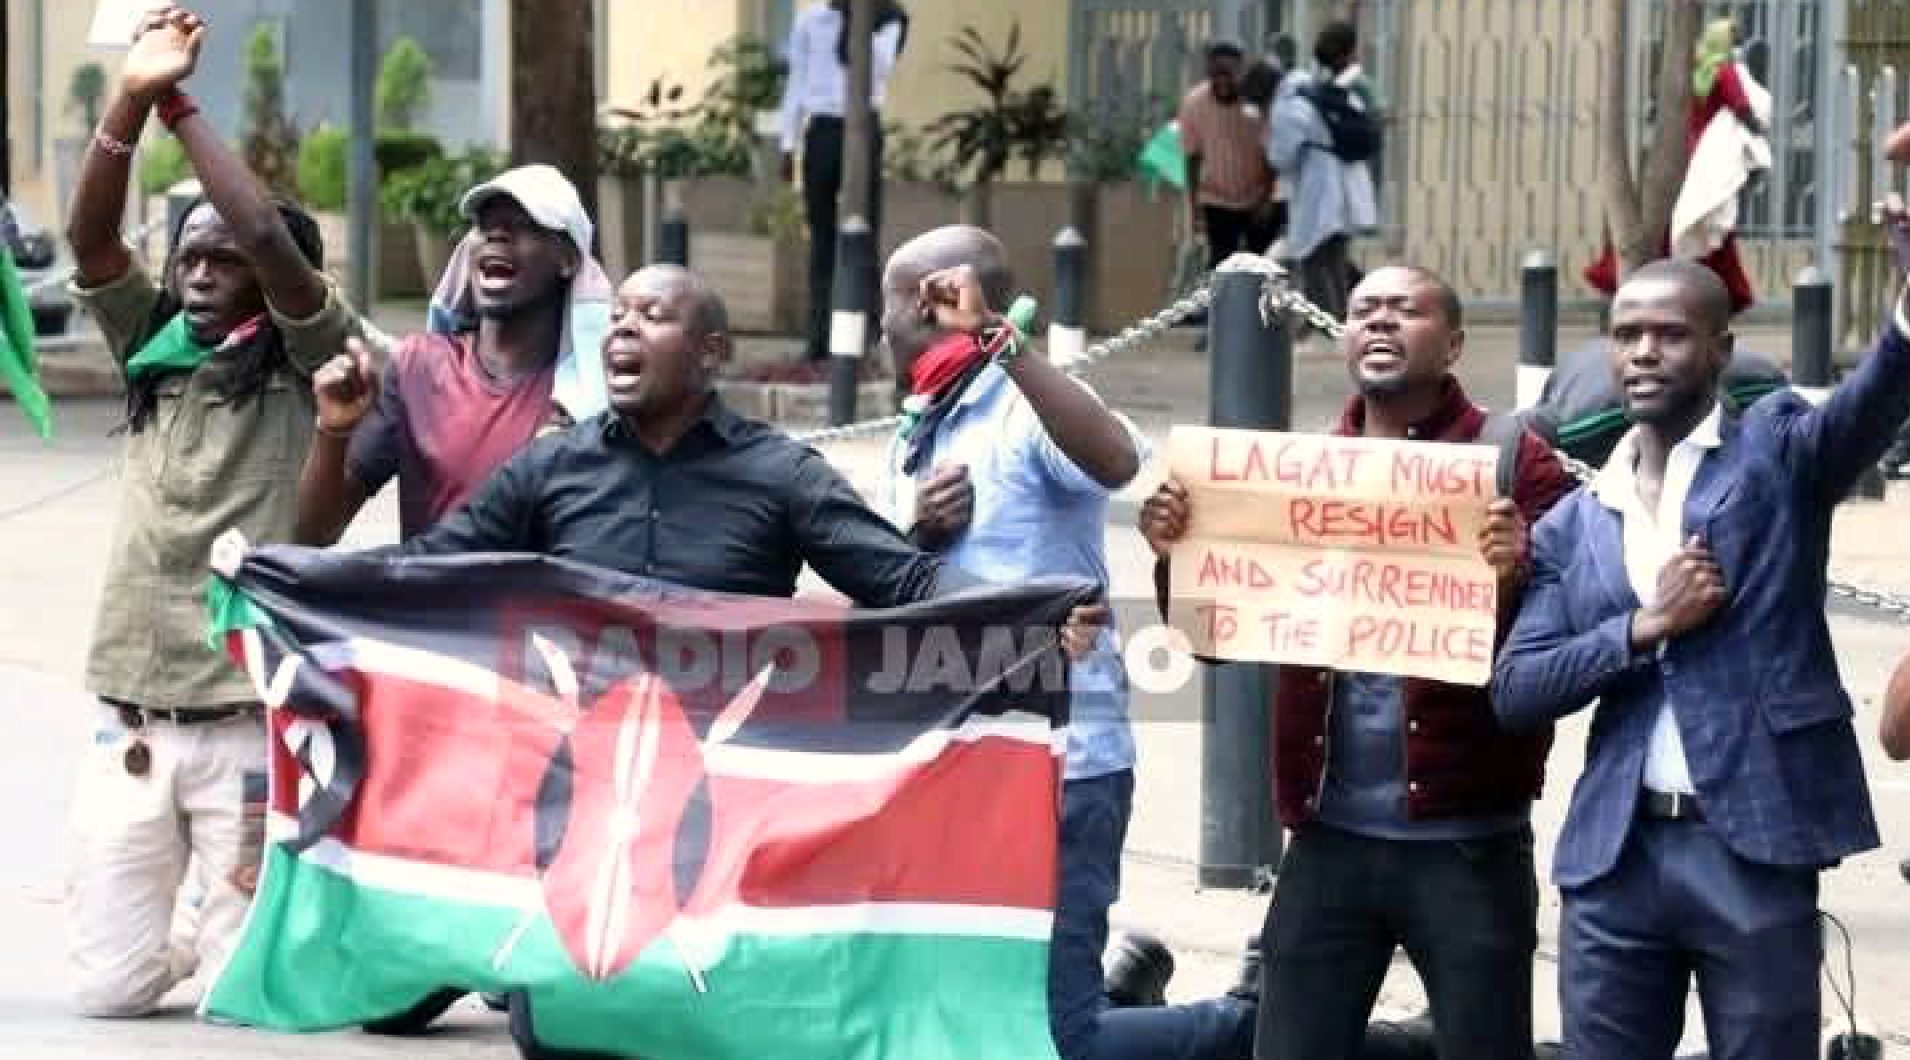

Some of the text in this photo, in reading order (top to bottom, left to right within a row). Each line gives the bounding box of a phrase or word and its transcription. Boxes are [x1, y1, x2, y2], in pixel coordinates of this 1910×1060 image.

[1210, 437, 1493, 495] LAGAT MUST
[1288, 498, 1459, 544] RESIGN
[1197, 549, 1496, 610] AND SURRENDER
[1195, 604, 1489, 661] TO THE POLICE
